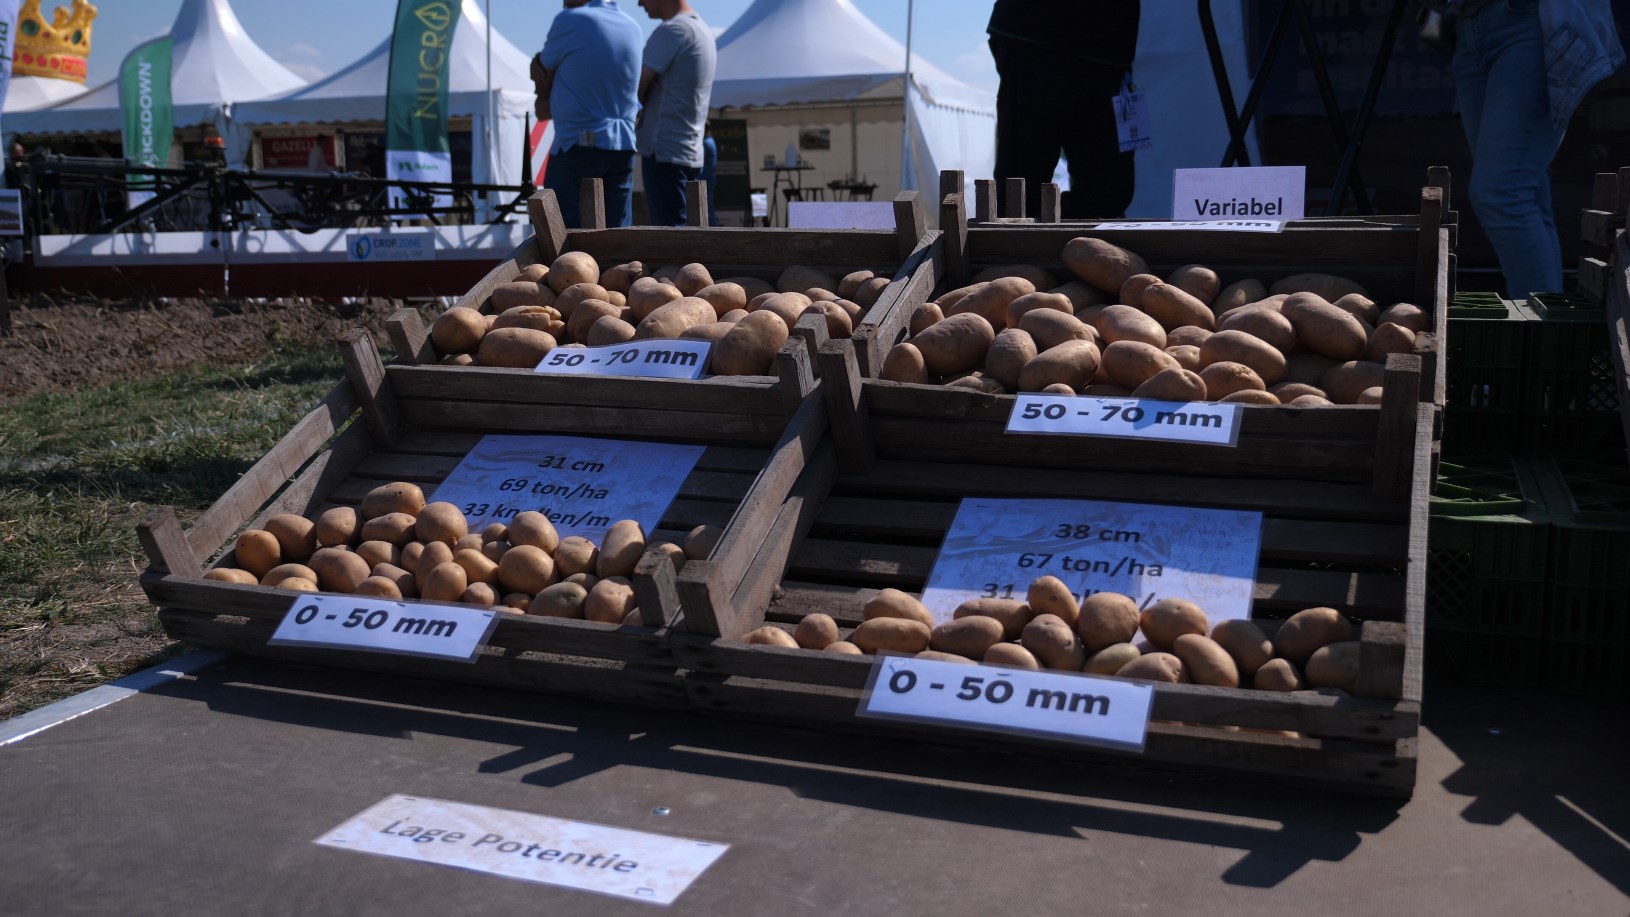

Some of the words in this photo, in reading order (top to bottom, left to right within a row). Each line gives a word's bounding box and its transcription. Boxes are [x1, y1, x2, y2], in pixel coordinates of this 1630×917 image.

[1194, 196, 1283, 216] Variabel
[547, 353, 585, 367] 50
[605, 348, 640, 366] 70
[644, 350, 698, 366] mm
[1021, 403, 1067, 420] 50
[1100, 405, 1145, 423] 70
[1154, 411, 1223, 428] mm
[538, 455, 567, 470] 31
[571, 460, 605, 473] cm
[499, 478, 529, 492] 69
[531, 480, 609, 500] ton/ha
[463, 503, 490, 516] 33
[492, 503, 611, 528] knlen/m
[1055, 523, 1091, 540] 38
[1099, 527, 1141, 543] cm
[1017, 552, 1054, 569] 67
[1061, 555, 1163, 577] ton/ha
[980, 583, 1015, 600] 31
[295, 604, 319, 625] 0
[342, 607, 389, 630] 50
[392, 616, 458, 637] mm
[888, 669, 917, 694] 0
[955, 675, 1014, 704] 50
[1025, 687, 1111, 716] mm
[379, 819, 466, 844] Lage
[471, 832, 640, 873] Potentie
